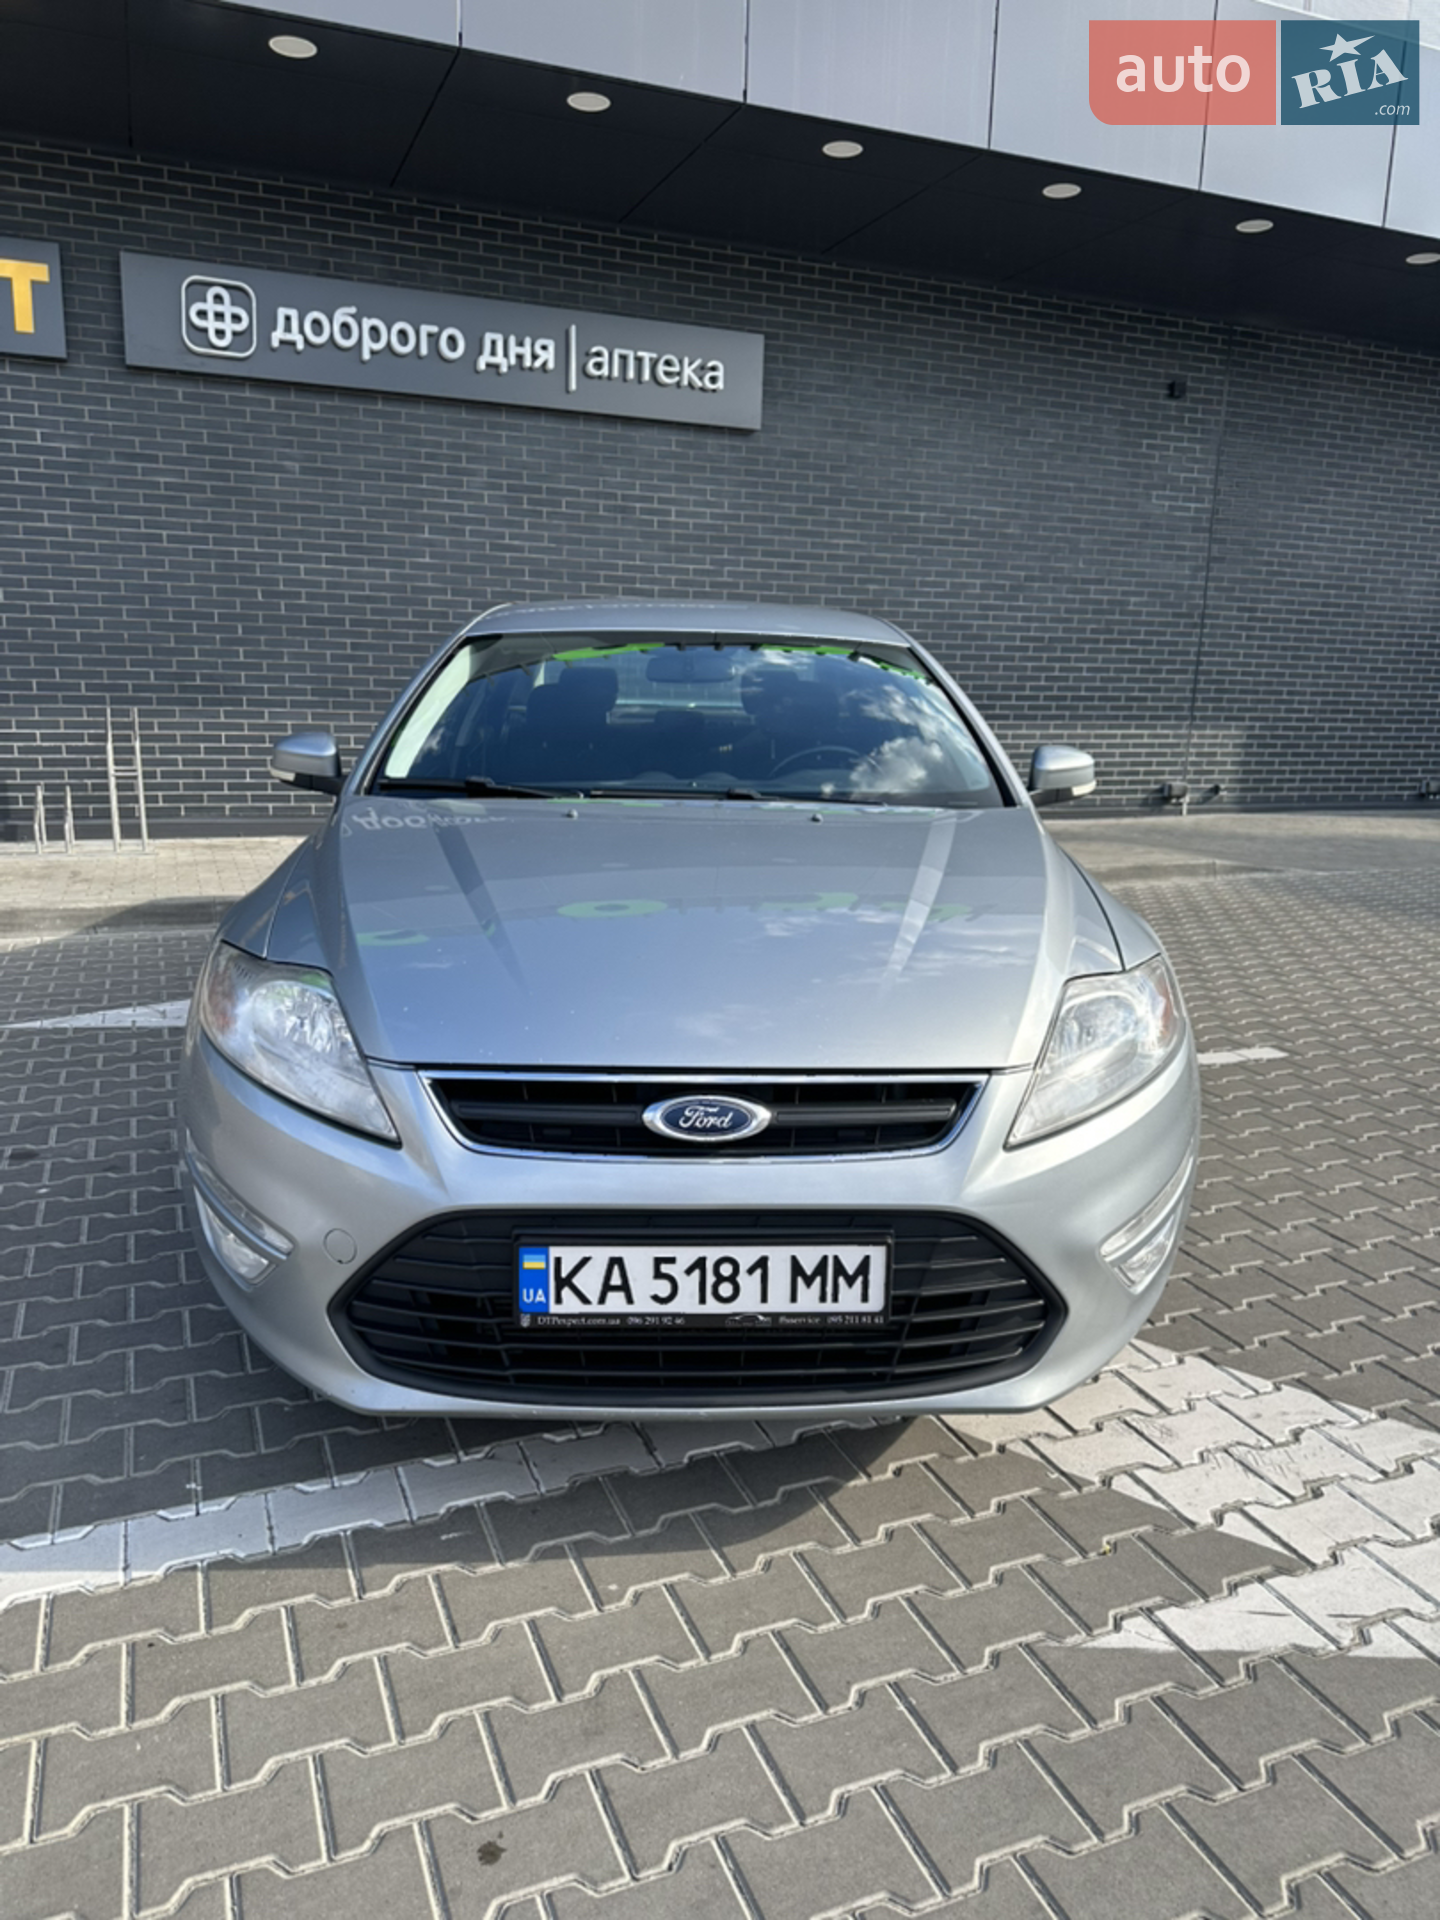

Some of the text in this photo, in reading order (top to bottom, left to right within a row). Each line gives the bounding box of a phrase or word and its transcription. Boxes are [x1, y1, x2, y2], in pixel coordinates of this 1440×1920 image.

[270, 305, 725, 391] доброго дня аптека
[678, 1104, 734, 1129] Ford
[522, 1288, 547, 1304] UA
[552, 1254, 872, 1306] KA 5181 MM
